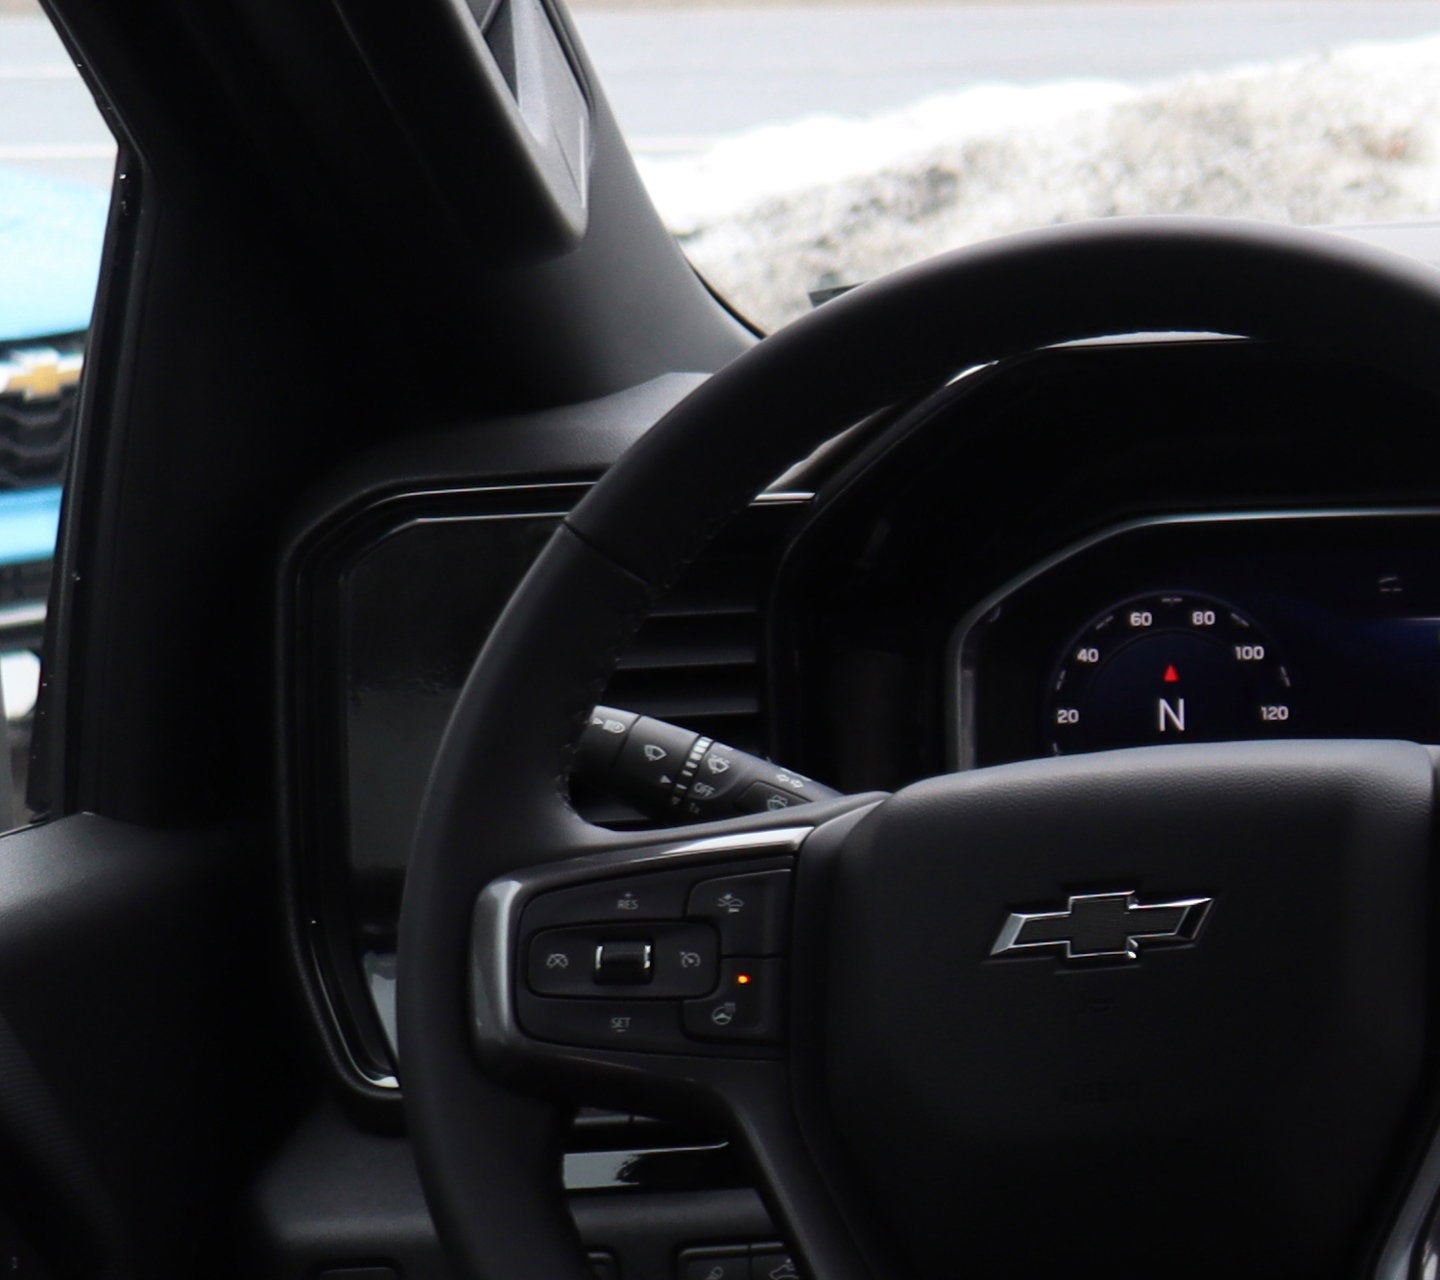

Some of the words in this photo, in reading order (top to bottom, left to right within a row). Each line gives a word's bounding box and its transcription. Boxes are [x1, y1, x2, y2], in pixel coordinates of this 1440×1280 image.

[1130, 610, 1153, 628] 60
[1192, 609, 1216, 627] 80
[1077, 647, 1100, 664] 40
[1234, 644, 1265, 662] 100
[1056, 707, 1080, 725] 20
[1158, 697, 1186, 732] N
[1260, 704, 1290, 723] 120
[616, 899, 639, 911] RES
[611, 1017, 631, 1029] SET
